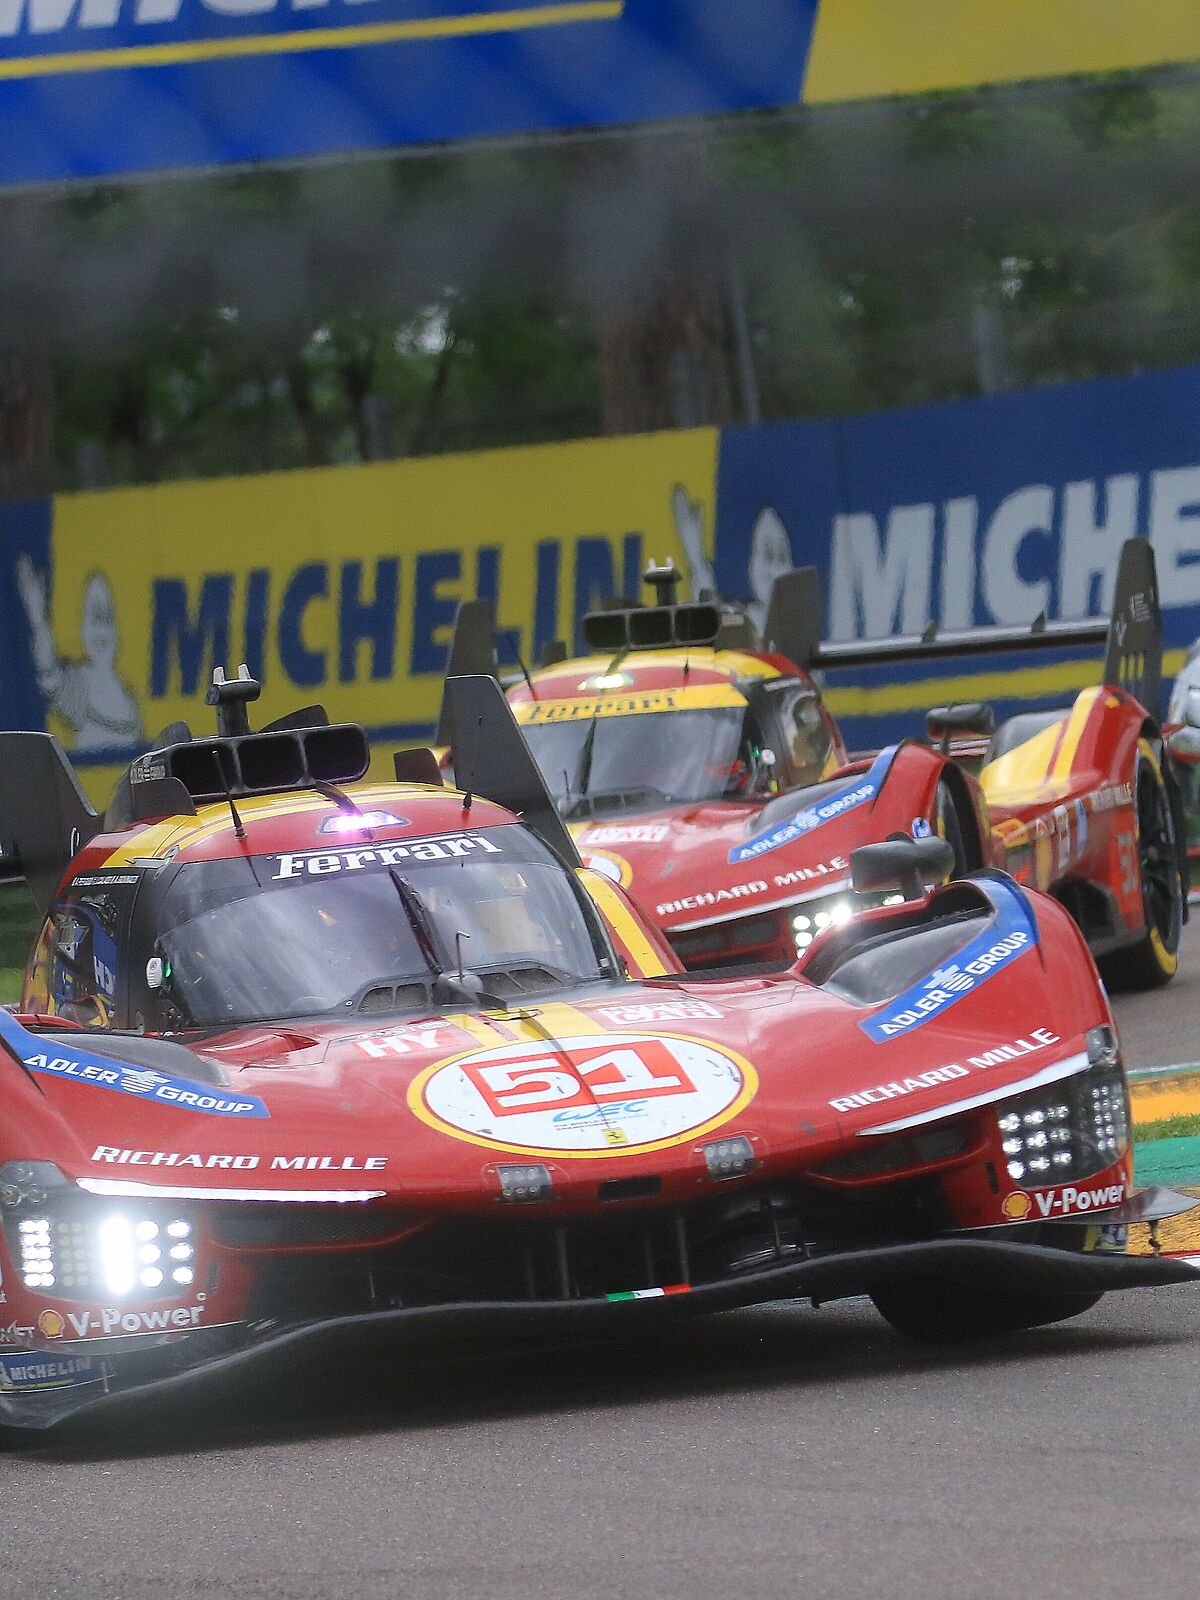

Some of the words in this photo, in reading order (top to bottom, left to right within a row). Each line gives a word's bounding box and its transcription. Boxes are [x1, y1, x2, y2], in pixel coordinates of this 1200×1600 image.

[739, 825, 798, 859] ADLER
[817, 784, 874, 818] GROUP
[271, 831, 503, 880] Ferrari
[656, 879, 769, 915] RICHARD
[774, 856, 849, 887] MILLE
[877, 988, 954, 1035] ADLER
[964, 931, 1029, 975] GROUP
[356, 1029, 440, 1058] HY
[828, 1063, 971, 1113] RICHARD
[966, 1027, 1061, 1069] MILLE
[23, 1053, 121, 1085] ADLER
[155, 1085, 255, 1113] GROUP
[477, 1048, 683, 1108] 51
[90, 1145, 261, 1170] RICHARD
[270, 1155, 388, 1171] MILLE
[1035, 1185, 1125, 1217] V-Power
[67, 1305, 205, 1337] V-Power
[10, 1355, 95, 1381] MICHELIN
